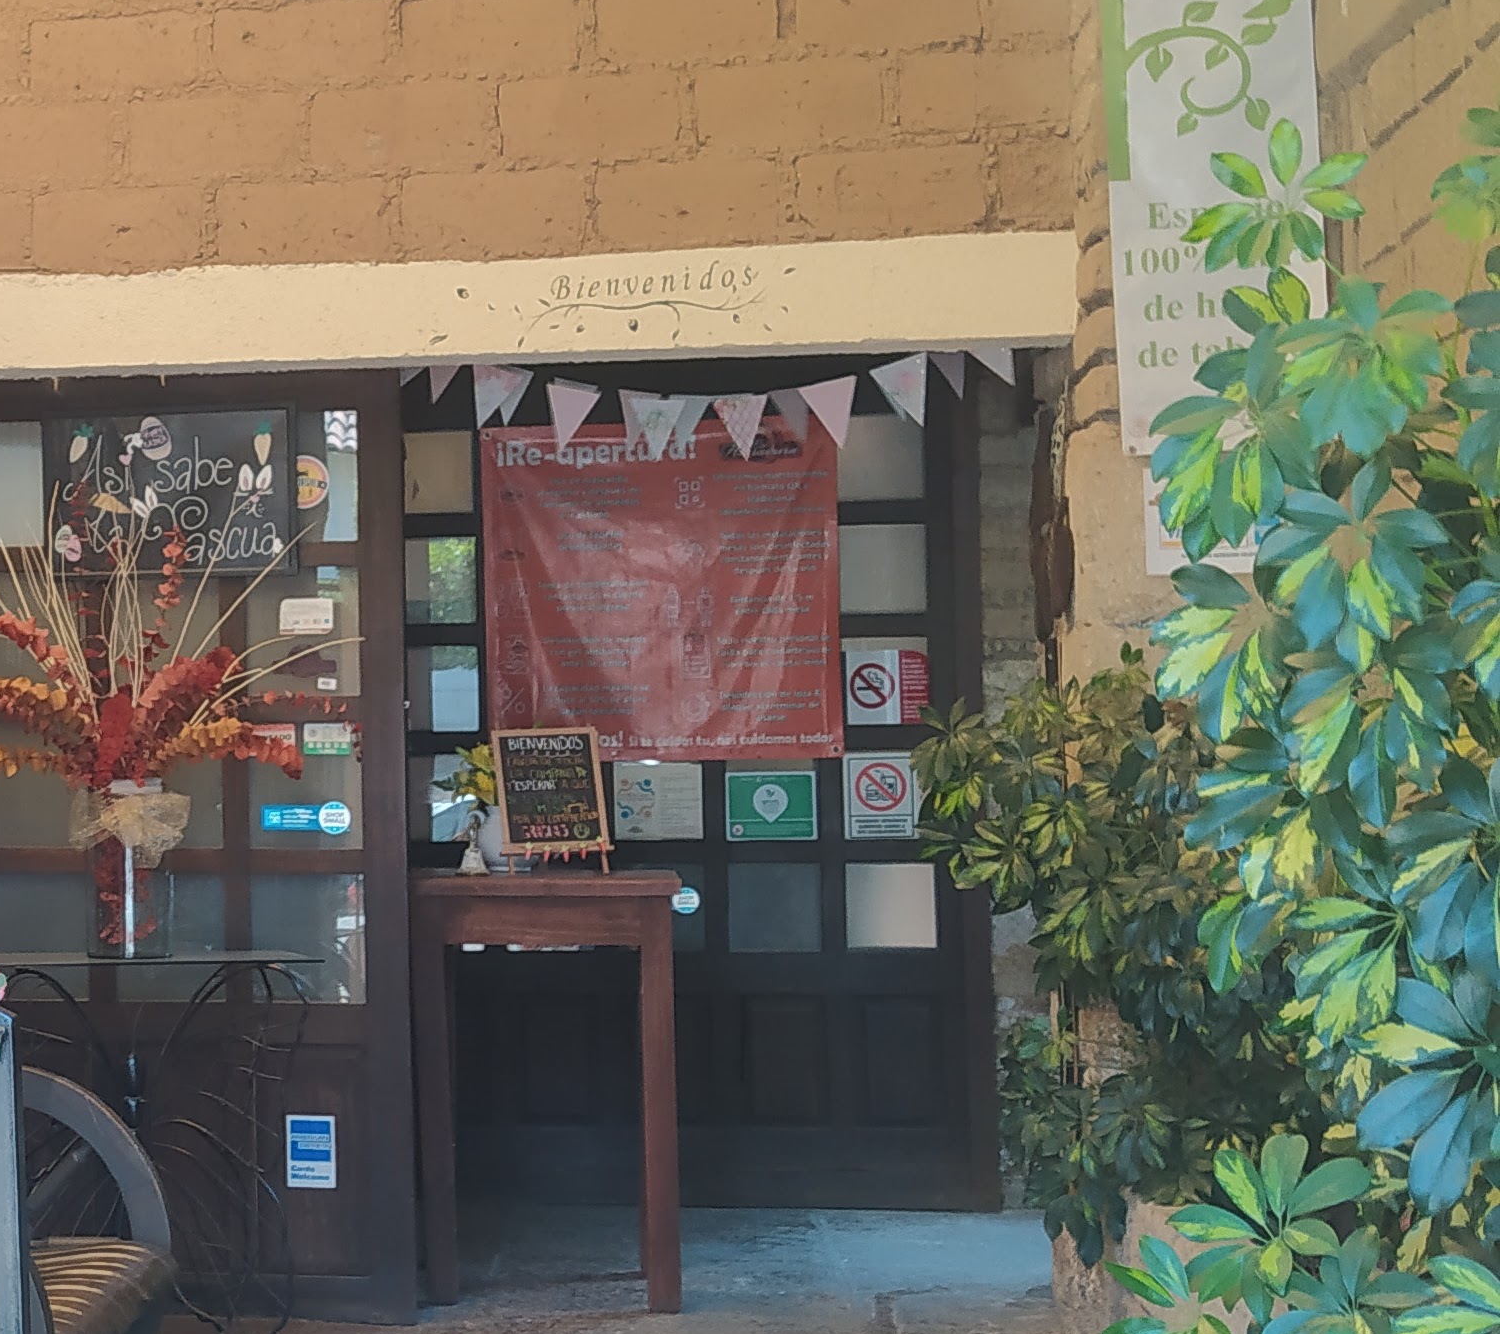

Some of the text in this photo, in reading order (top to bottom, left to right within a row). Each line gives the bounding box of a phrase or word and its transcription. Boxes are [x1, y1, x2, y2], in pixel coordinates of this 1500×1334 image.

[550, 259, 754, 301] Bienvenidos
[1143, 293, 1184, 323] de
[1137, 340, 1180, 369] de
[153, 435, 234, 494] sabe
[507, 735, 584, 752] BIENVENIDOS
